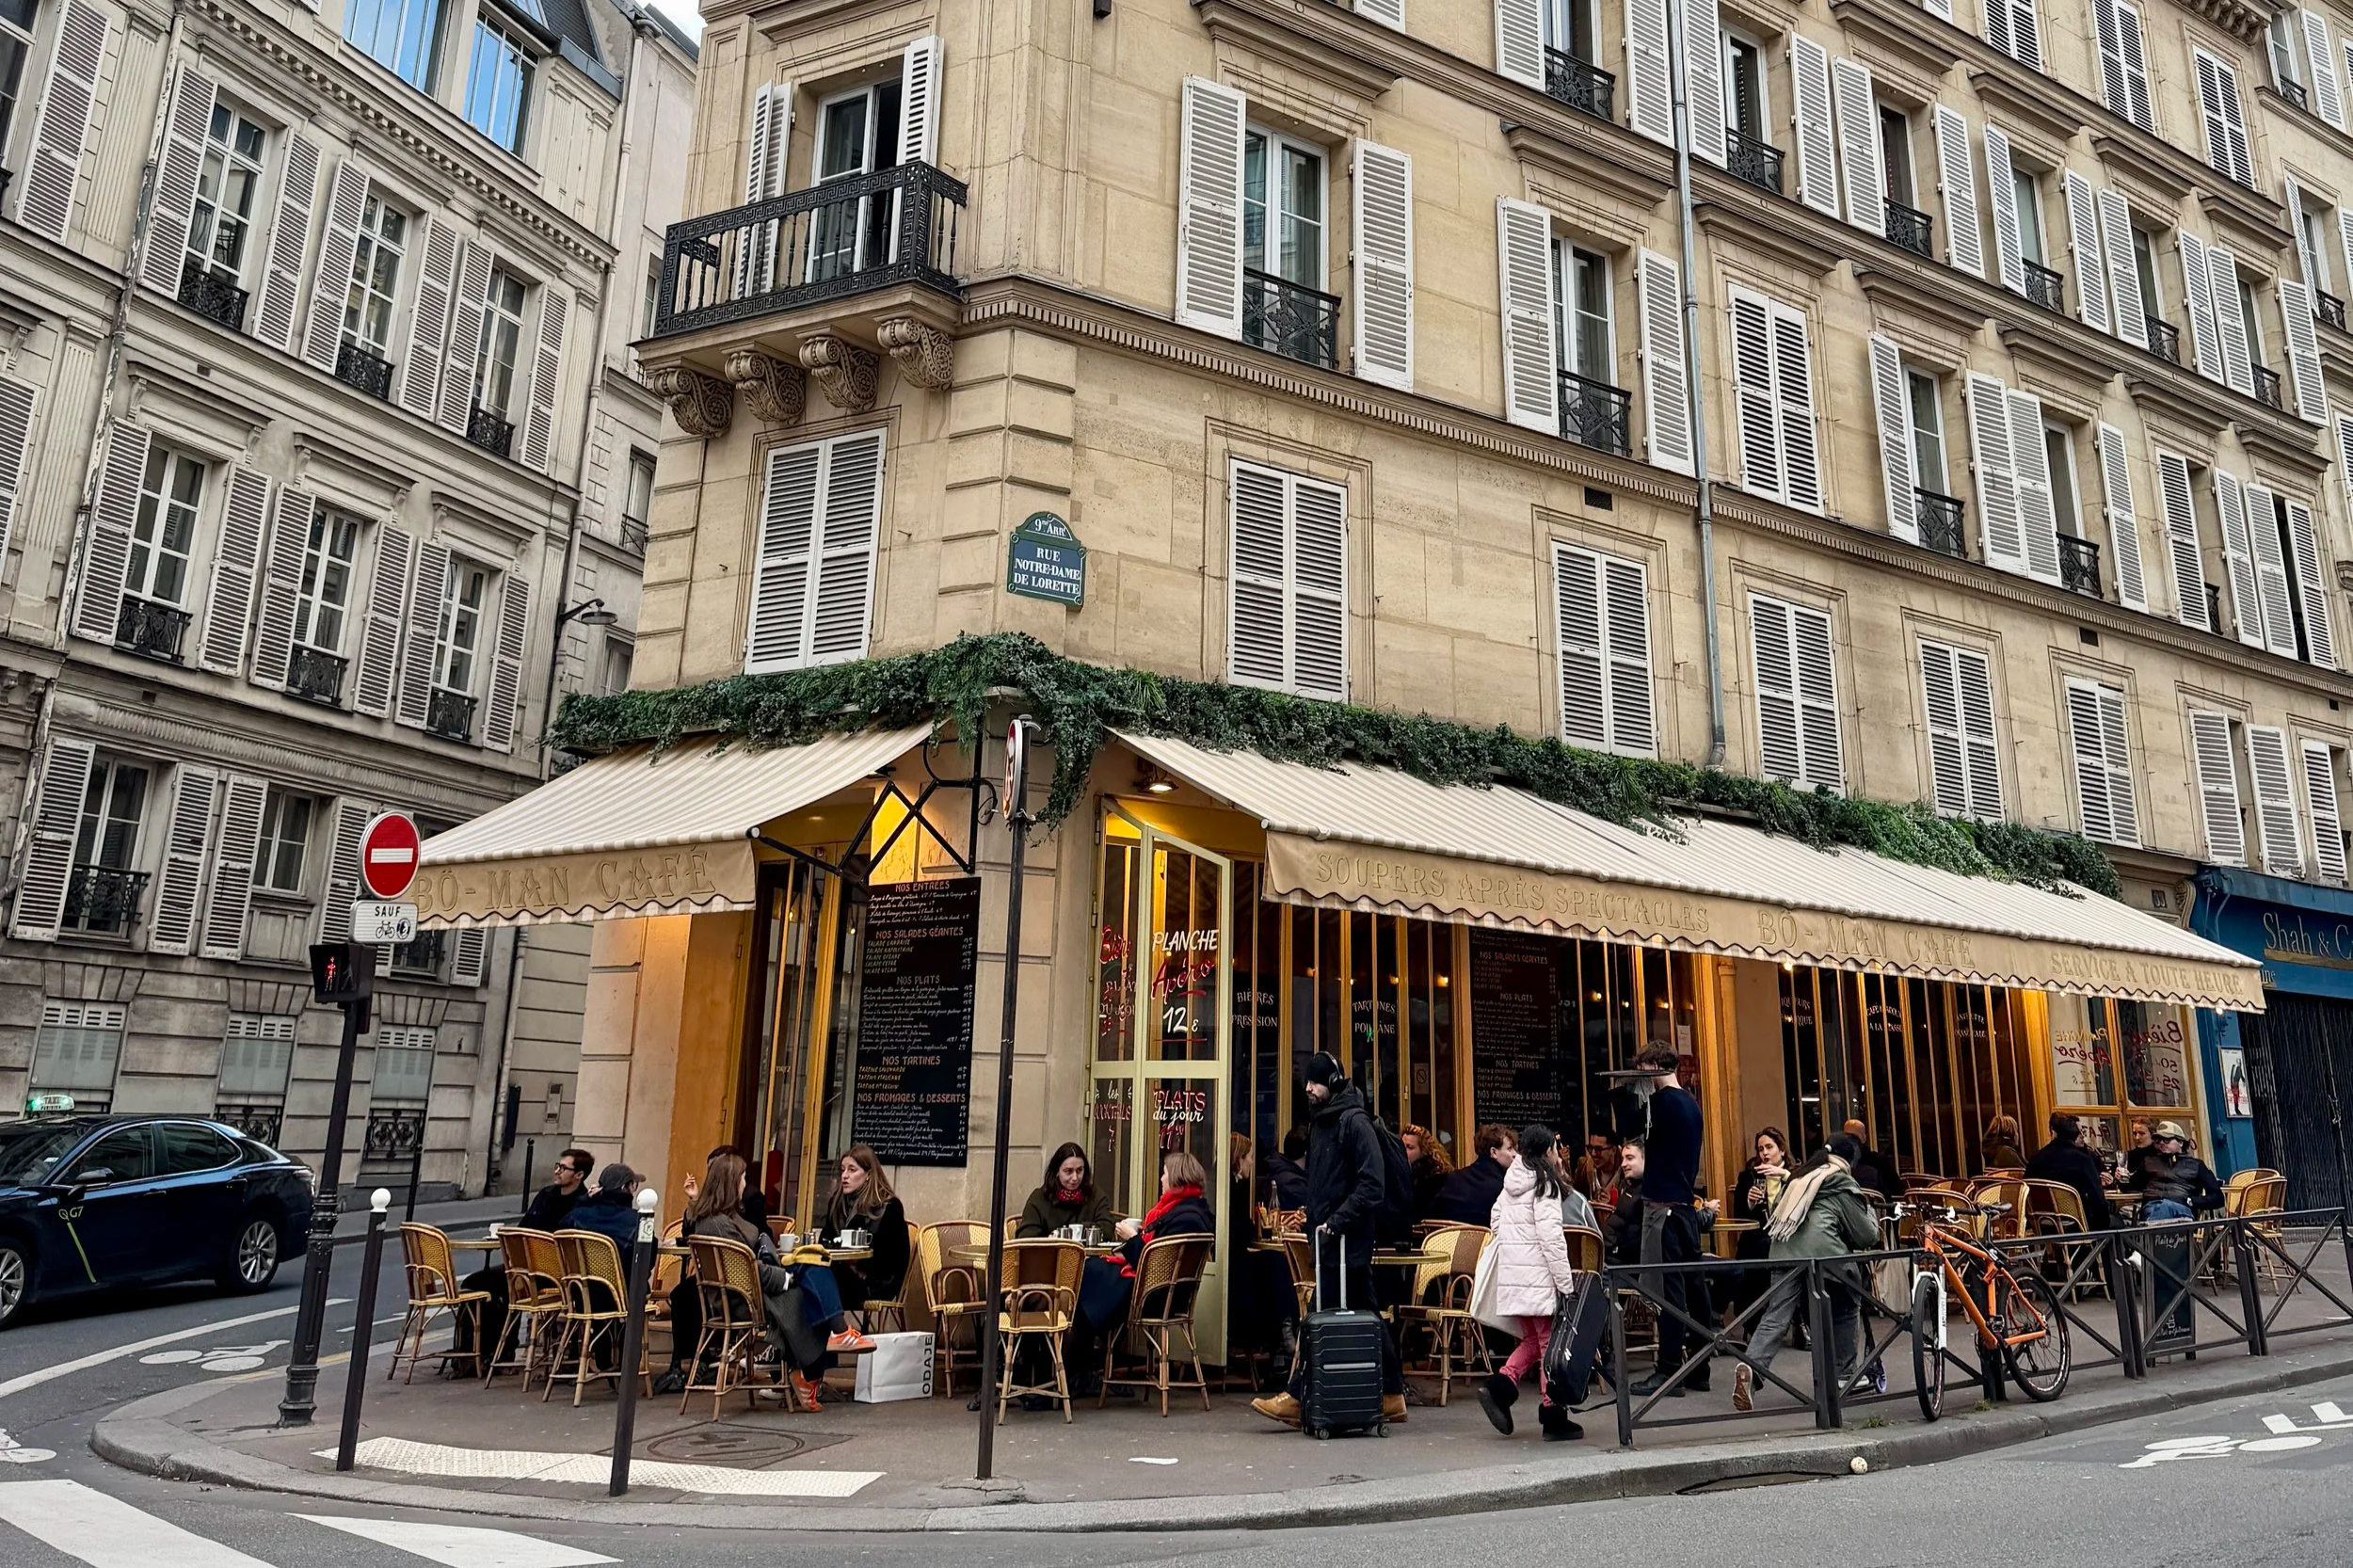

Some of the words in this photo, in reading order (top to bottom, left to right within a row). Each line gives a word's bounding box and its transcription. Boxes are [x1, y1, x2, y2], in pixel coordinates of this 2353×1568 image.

[1037, 547, 1060, 562] RUE
[1015, 558, 1080, 580] NOTRE-DAME
[1014, 573, 1028, 584] DE
[1032, 576, 1079, 595] LORETTE
[598, 844, 716, 904] CAFÉ
[895, 883, 909, 892] NOS
[1316, 854, 1445, 898] SOUPERS
[1457, 873, 1544, 911] APRÈS
[1555, 888, 1709, 933] SPECTACLES
[375, 906, 400, 917] SAUF
[876, 931, 891, 939] NOS
[894, 928, 927, 938] SALADES
[1152, 929, 1220, 952] PLANCHE
[2264, 913, 2313, 955] Shah
[2319, 932, 2330, 958] &
[1905, 929, 1976, 968] CAFÉ
[897, 976, 911, 985] NOS
[915, 975, 940, 984] PLATS
[1151, 957, 1215, 1004] Apéro
[2051, 952, 2121, 982] SERVICE
[2140, 962, 2188, 989] TOUTE
[2194, 968, 2244, 996] HEURE
[1163, 1007, 1188, 1033] 12
[1231, 1015, 1277, 1028] PRESSION
[883, 1056, 899, 1065] NOS
[904, 1055, 940, 1065] TARTINES
[857, 1093, 872, 1102] NOS
[874, 1093, 915, 1103] FROMAGES
[920, 1094, 923, 1103] &
[926, 1094, 966, 1103] DESSERTS
[1108, 1080, 1119, 1099] les
[1153, 1089, 1207, 1112] PLATS
[1153, 1106, 1167, 1120] du
[1167, 1107, 1204, 1129] jour
[70, 1206, 84, 1218] G7
[922, 1336, 933, 1395] ODAJE
